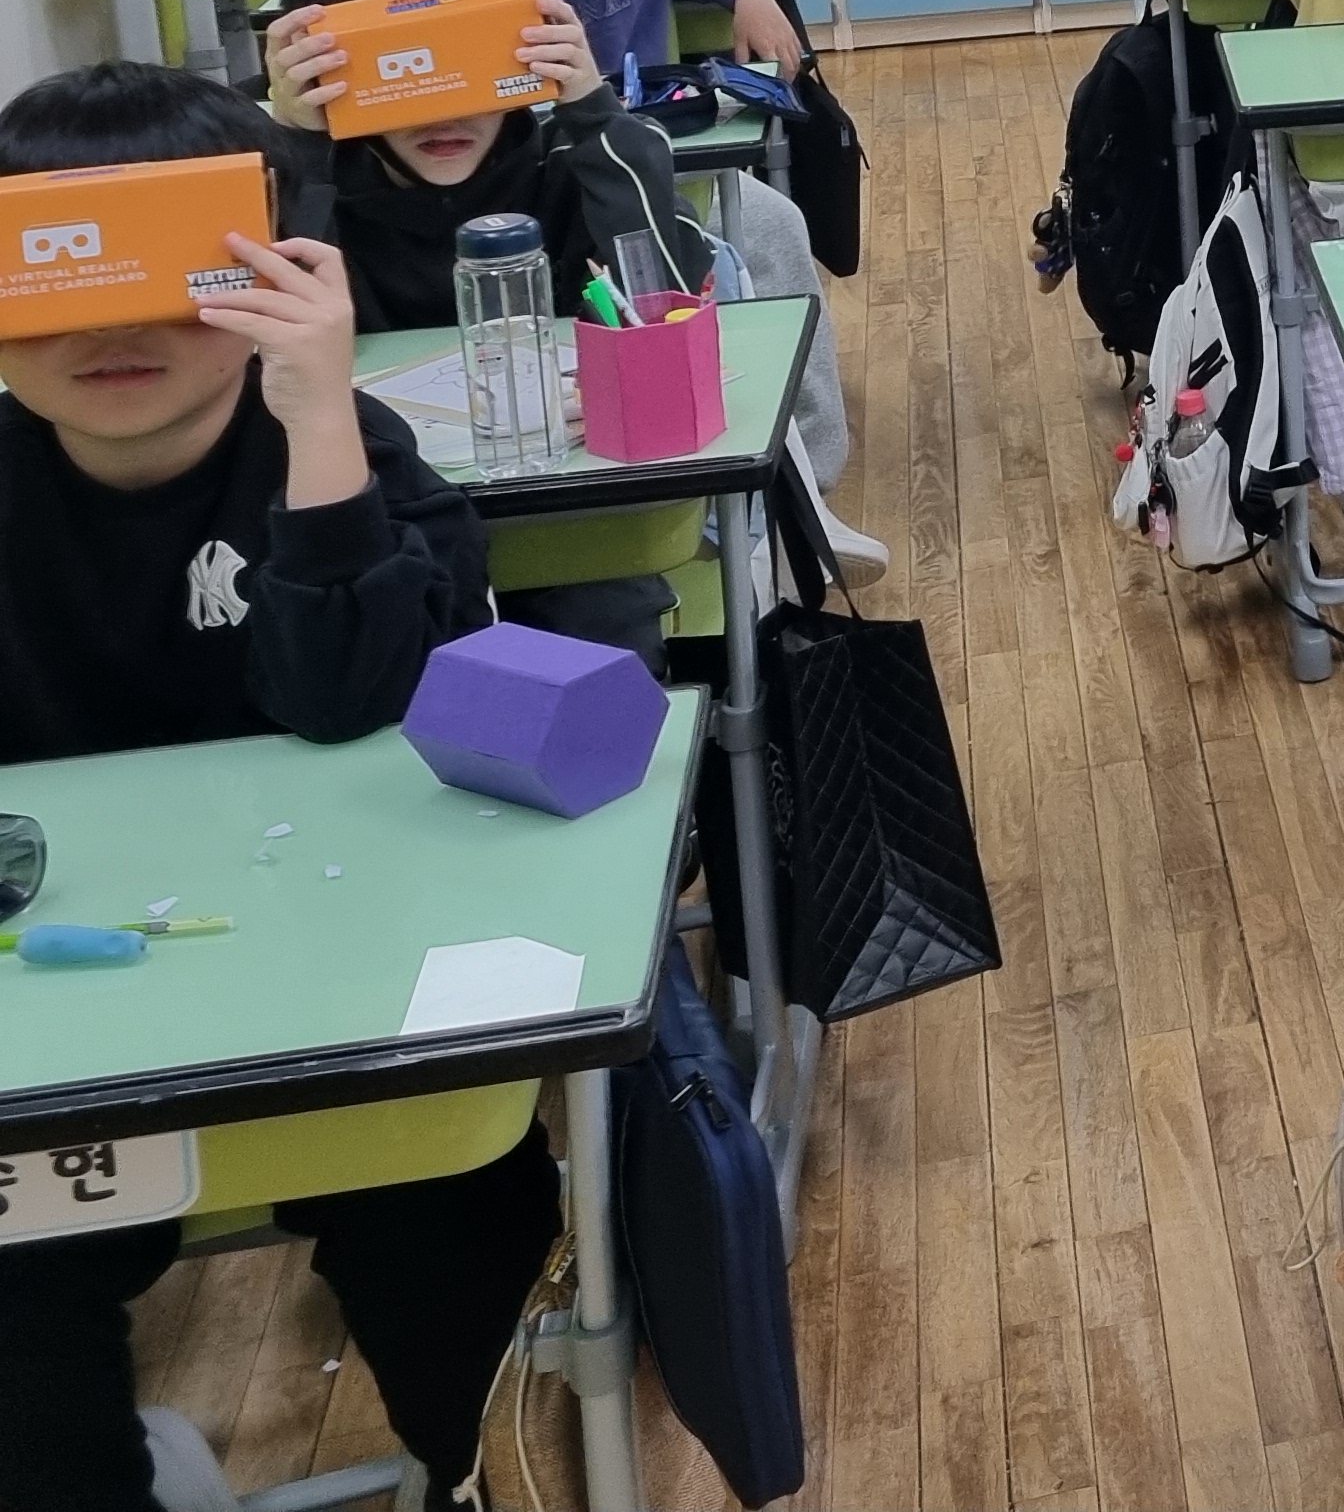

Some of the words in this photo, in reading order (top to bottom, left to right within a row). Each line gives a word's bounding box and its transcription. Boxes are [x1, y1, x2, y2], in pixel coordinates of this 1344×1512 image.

[371, 80, 417, 96] VIRTUAL
[418, 71, 463, 86] REALITY
[403, 80, 468, 98] CARDBOARD
[8, 266, 74, 284] VIRTUAL
[77, 258, 141, 276] REALITY
[53, 271, 148, 292] CARDBOARD
[0, 1141, 118, 1217] 현
